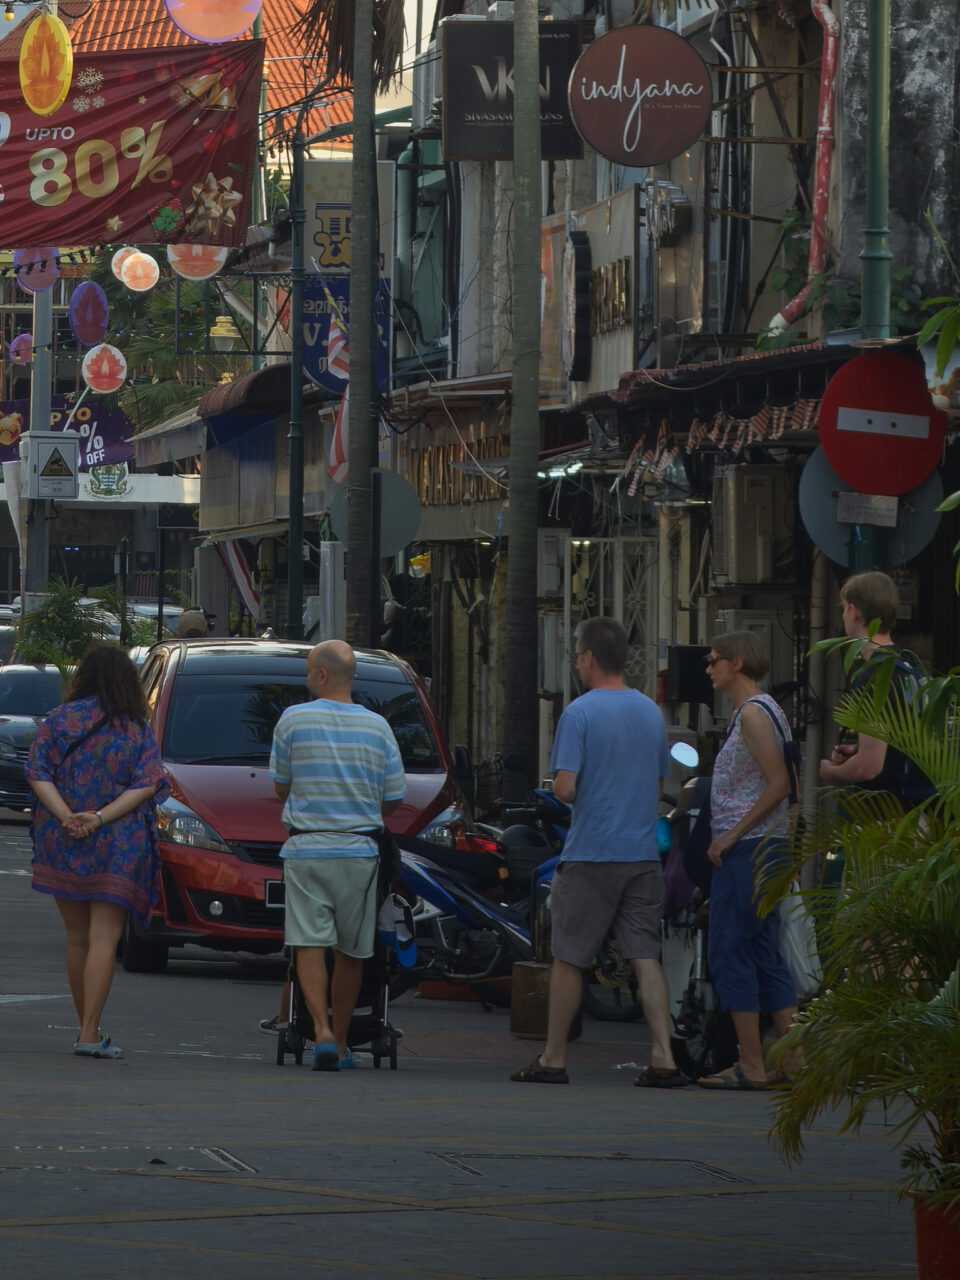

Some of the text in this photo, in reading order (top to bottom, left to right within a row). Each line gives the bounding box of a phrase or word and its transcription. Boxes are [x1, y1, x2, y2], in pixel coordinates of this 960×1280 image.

[581, 43, 704, 152] indyana
[464, 112, 564, 122] SIVASAM ONS
[24, 126, 76, 144] UPTO
[29, 119, 173, 207] 80%
[86, 448, 107, 466] OFF
